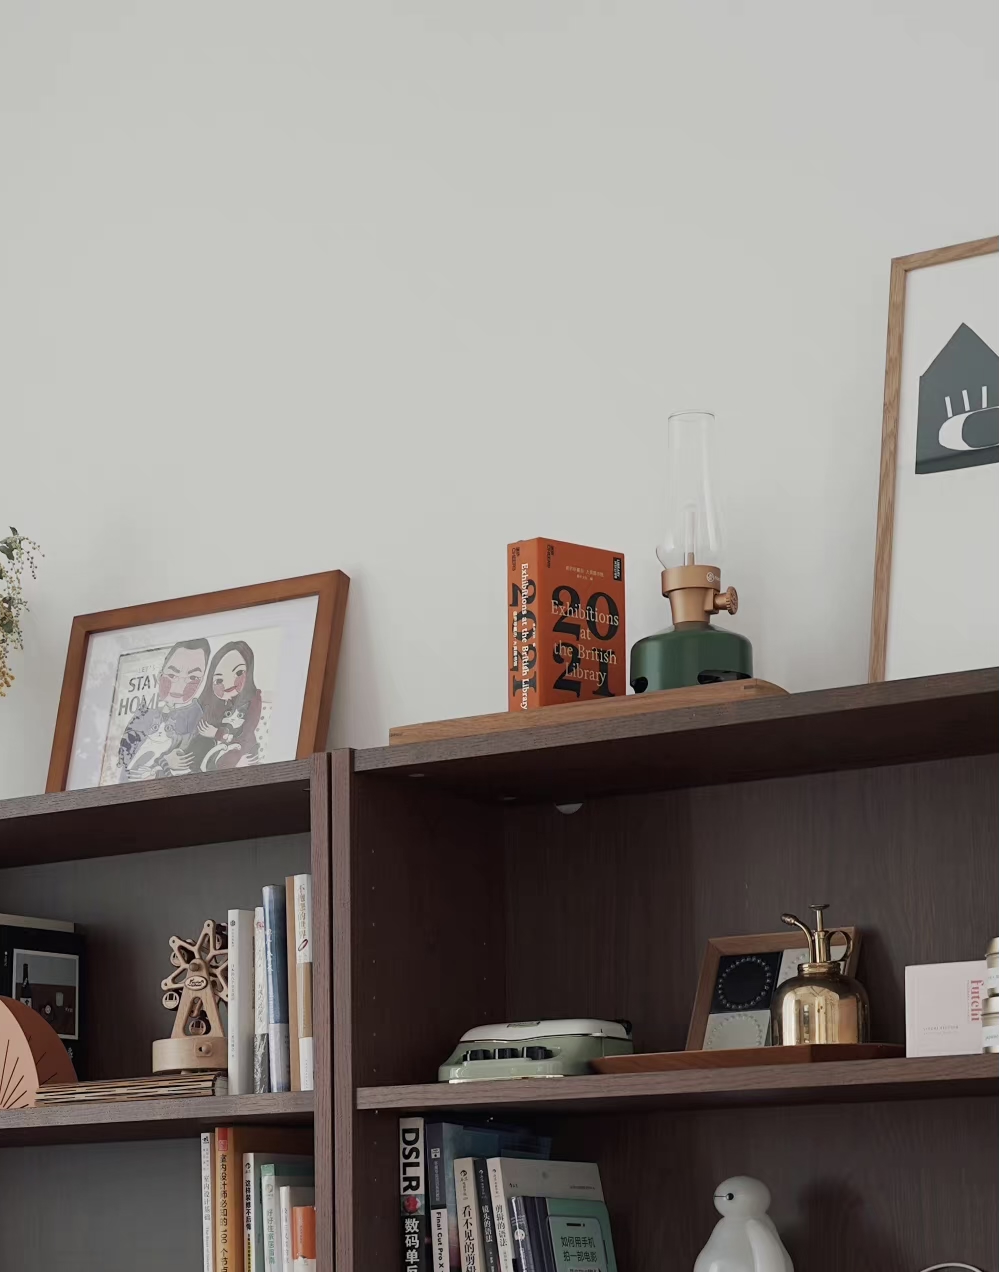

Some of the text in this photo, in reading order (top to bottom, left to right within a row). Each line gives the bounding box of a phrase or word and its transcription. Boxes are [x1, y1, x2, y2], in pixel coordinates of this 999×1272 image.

[521, 617, 528, 625] at
[551, 600, 619, 626] Exhibitions
[552, 585, 620, 642] 20
[580, 627, 591, 640] at
[521, 645, 529, 676] British
[554, 640, 617, 665] the British
[128, 674, 159, 692] STAY
[553, 642, 616, 698] 21
[565, 661, 607, 687] Library
[520, 678, 530, 710] Library
[401, 1127, 420, 1194] DSLR
[203, 1175, 211, 1221] 室内设计基础
[266, 1208, 276, 1265] 好好住家居指南
[481, 1205, 493, 1243] 镜头的语法
[495, 1204, 508, 1247] 剪辑的语法
[560, 1235, 596, 1248] 如何用手机
[563, 1250, 598, 1263] 拍一部电影
